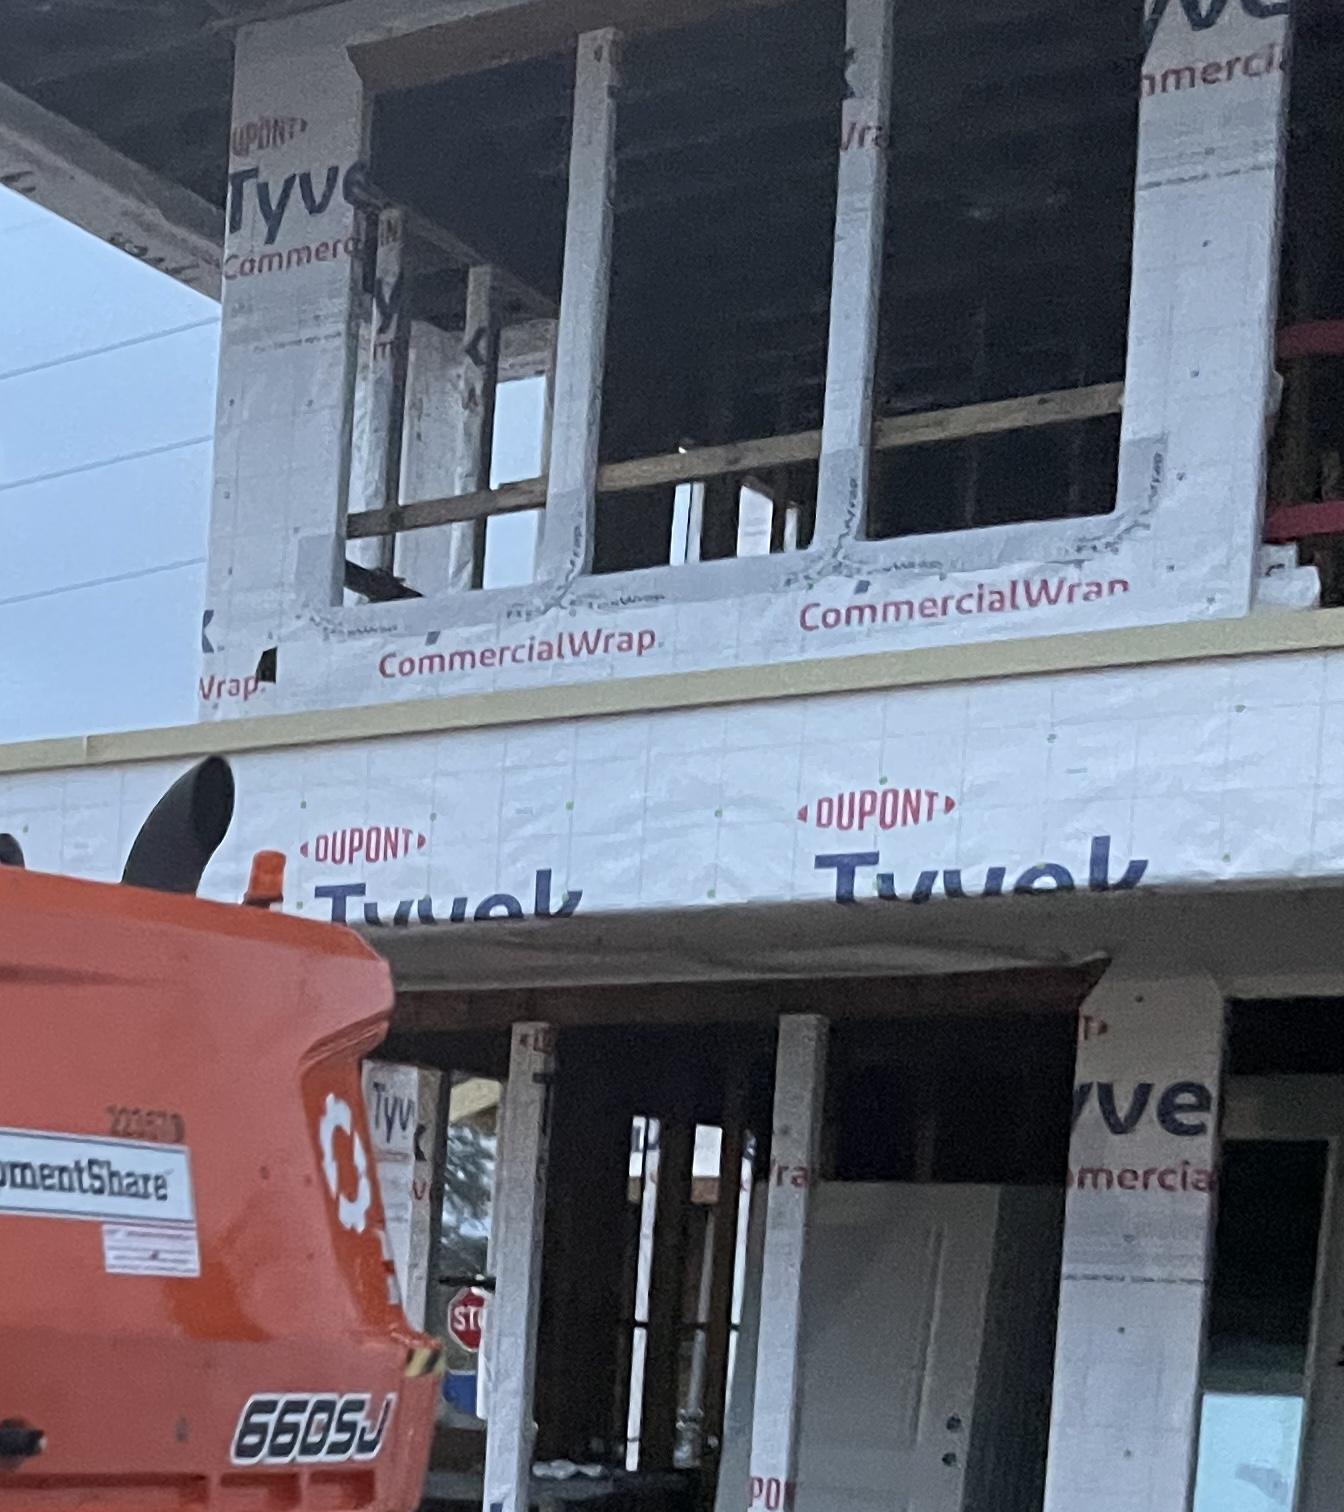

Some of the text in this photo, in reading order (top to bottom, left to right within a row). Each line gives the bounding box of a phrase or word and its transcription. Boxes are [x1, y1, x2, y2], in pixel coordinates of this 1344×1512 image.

[378, 628, 657, 679] CommercialWrap
[815, 786, 939, 832] DUPONT
[314, 826, 414, 865] DUPONT
[1066, 1159, 1216, 1193] mercia
[453, 1304, 481, 1331] ST
[230, 1392, 399, 1466] 660SJ
